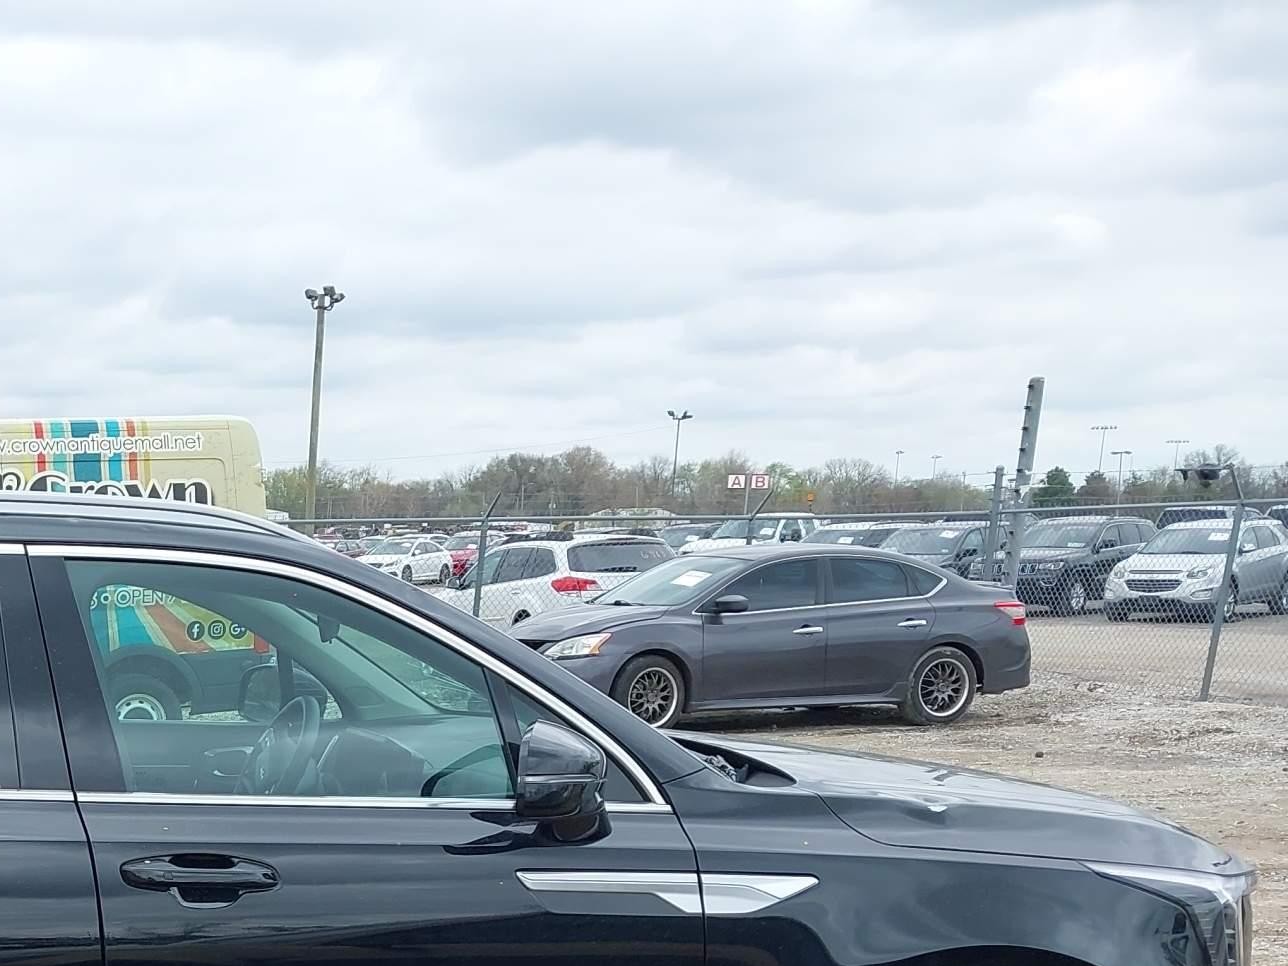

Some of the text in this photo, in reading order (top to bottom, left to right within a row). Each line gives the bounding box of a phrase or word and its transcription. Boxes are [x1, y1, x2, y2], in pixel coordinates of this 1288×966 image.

[730, 475, 742, 488] A
[754, 475, 766, 488] B
[114, 587, 164, 607] OPEN
